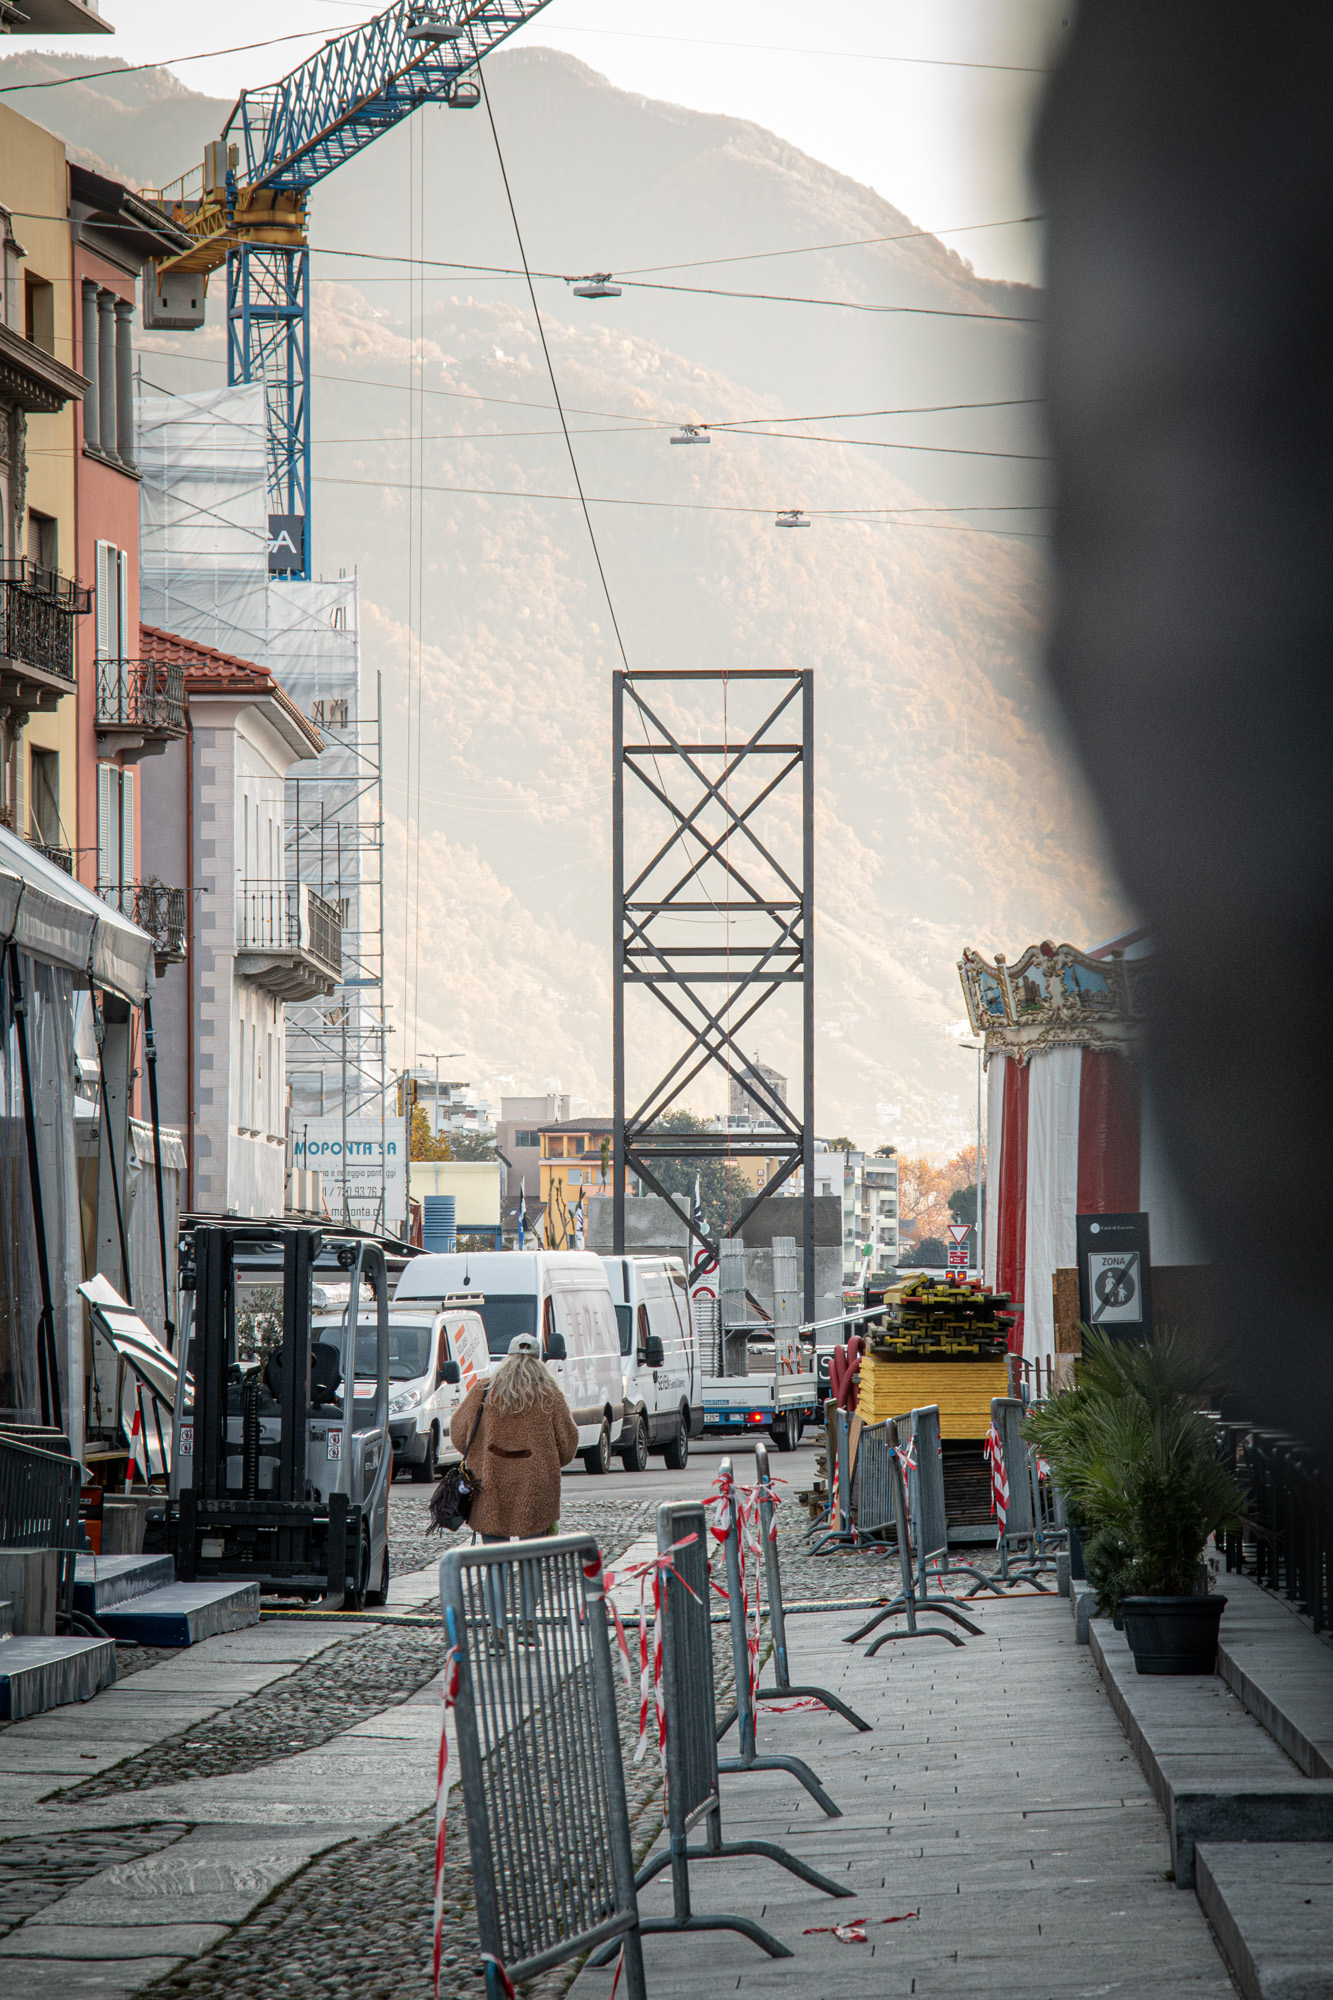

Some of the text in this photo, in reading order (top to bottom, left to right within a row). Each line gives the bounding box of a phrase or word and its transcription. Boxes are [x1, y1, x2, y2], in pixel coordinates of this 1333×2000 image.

[294, 1141, 373, 1155] MOPONTA
[336, 1168, 366, 1179] noeggio
[366, 1168, 397, 1179] pontggi
[1101, 1257, 1126, 1267] ZONA
